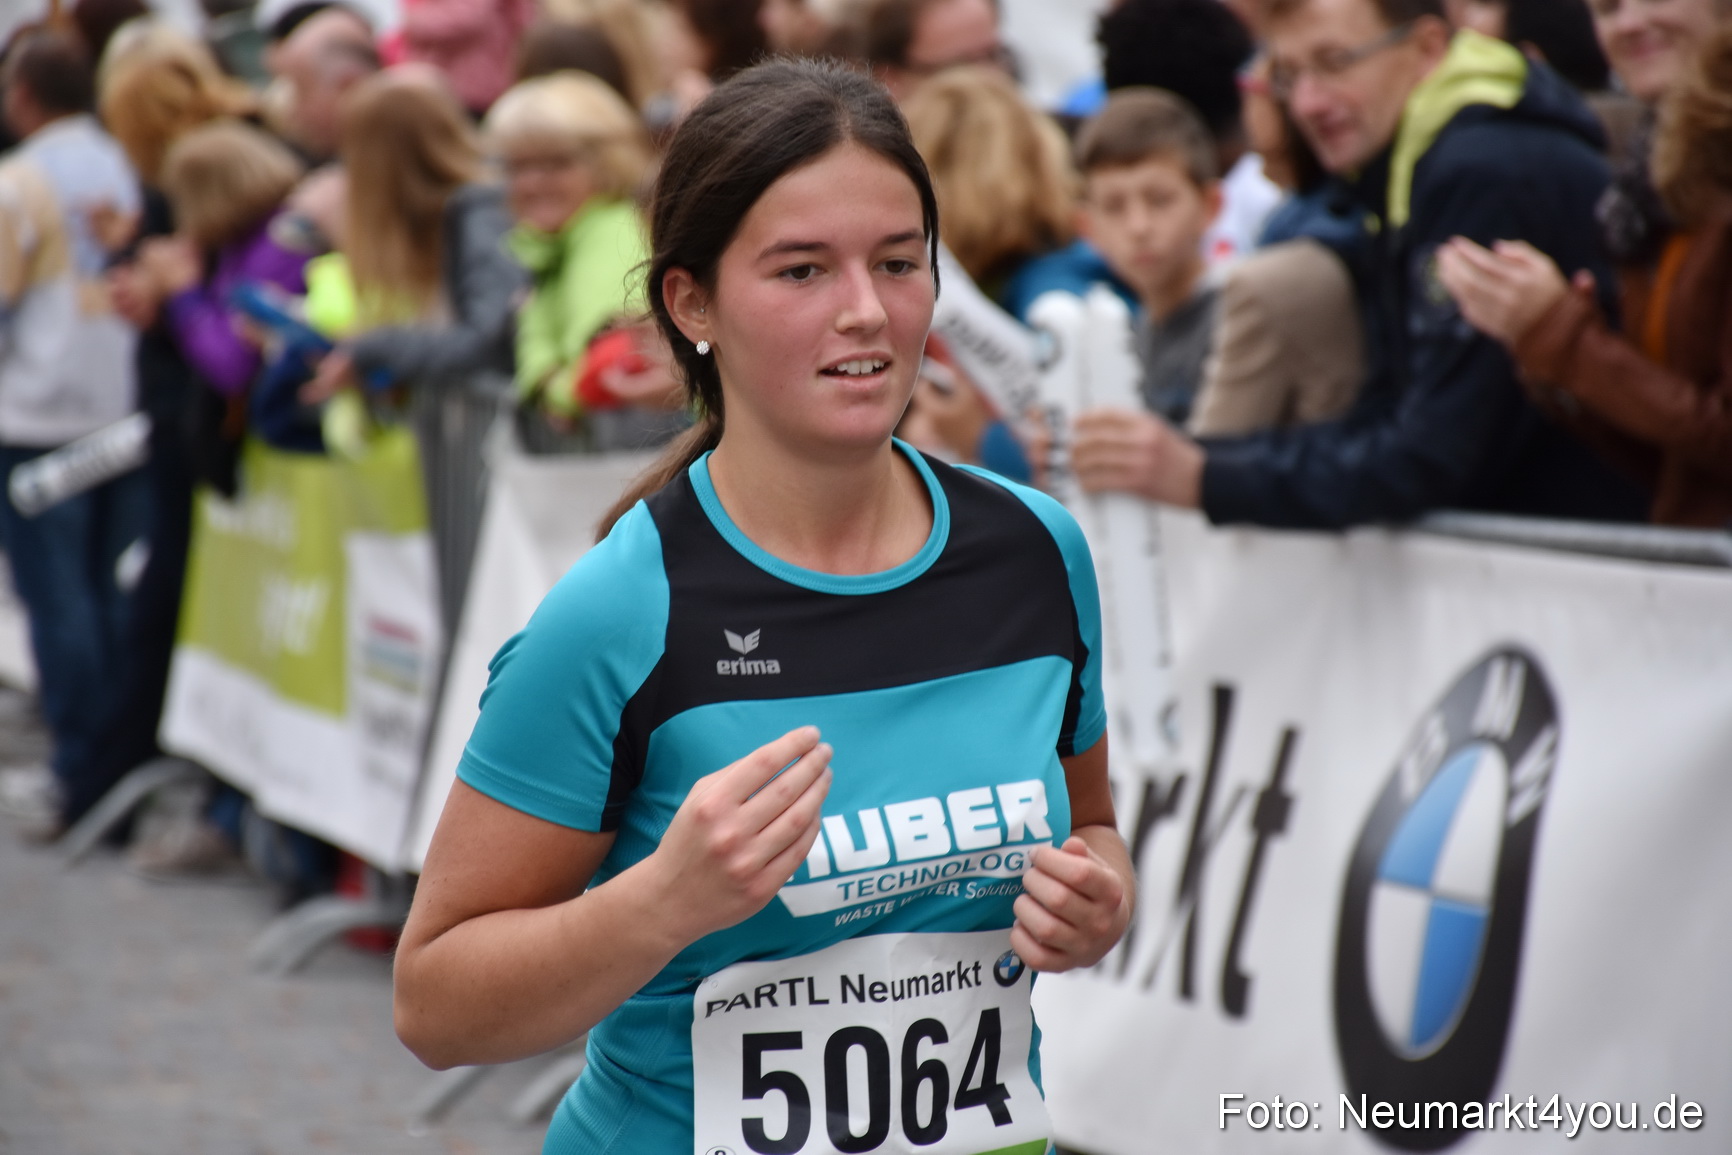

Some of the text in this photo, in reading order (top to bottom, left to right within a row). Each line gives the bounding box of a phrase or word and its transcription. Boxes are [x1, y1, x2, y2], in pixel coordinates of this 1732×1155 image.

[716, 656, 781, 675] erima
[836, 851, 1034, 902] TECHNOLOG
[1086, 680, 1300, 1020] rkt
[834, 880, 1027, 928] WASTE WTER Solution
[704, 960, 982, 1019] PARTL Neumarkt
[741, 1006, 1014, 1155] 5064
